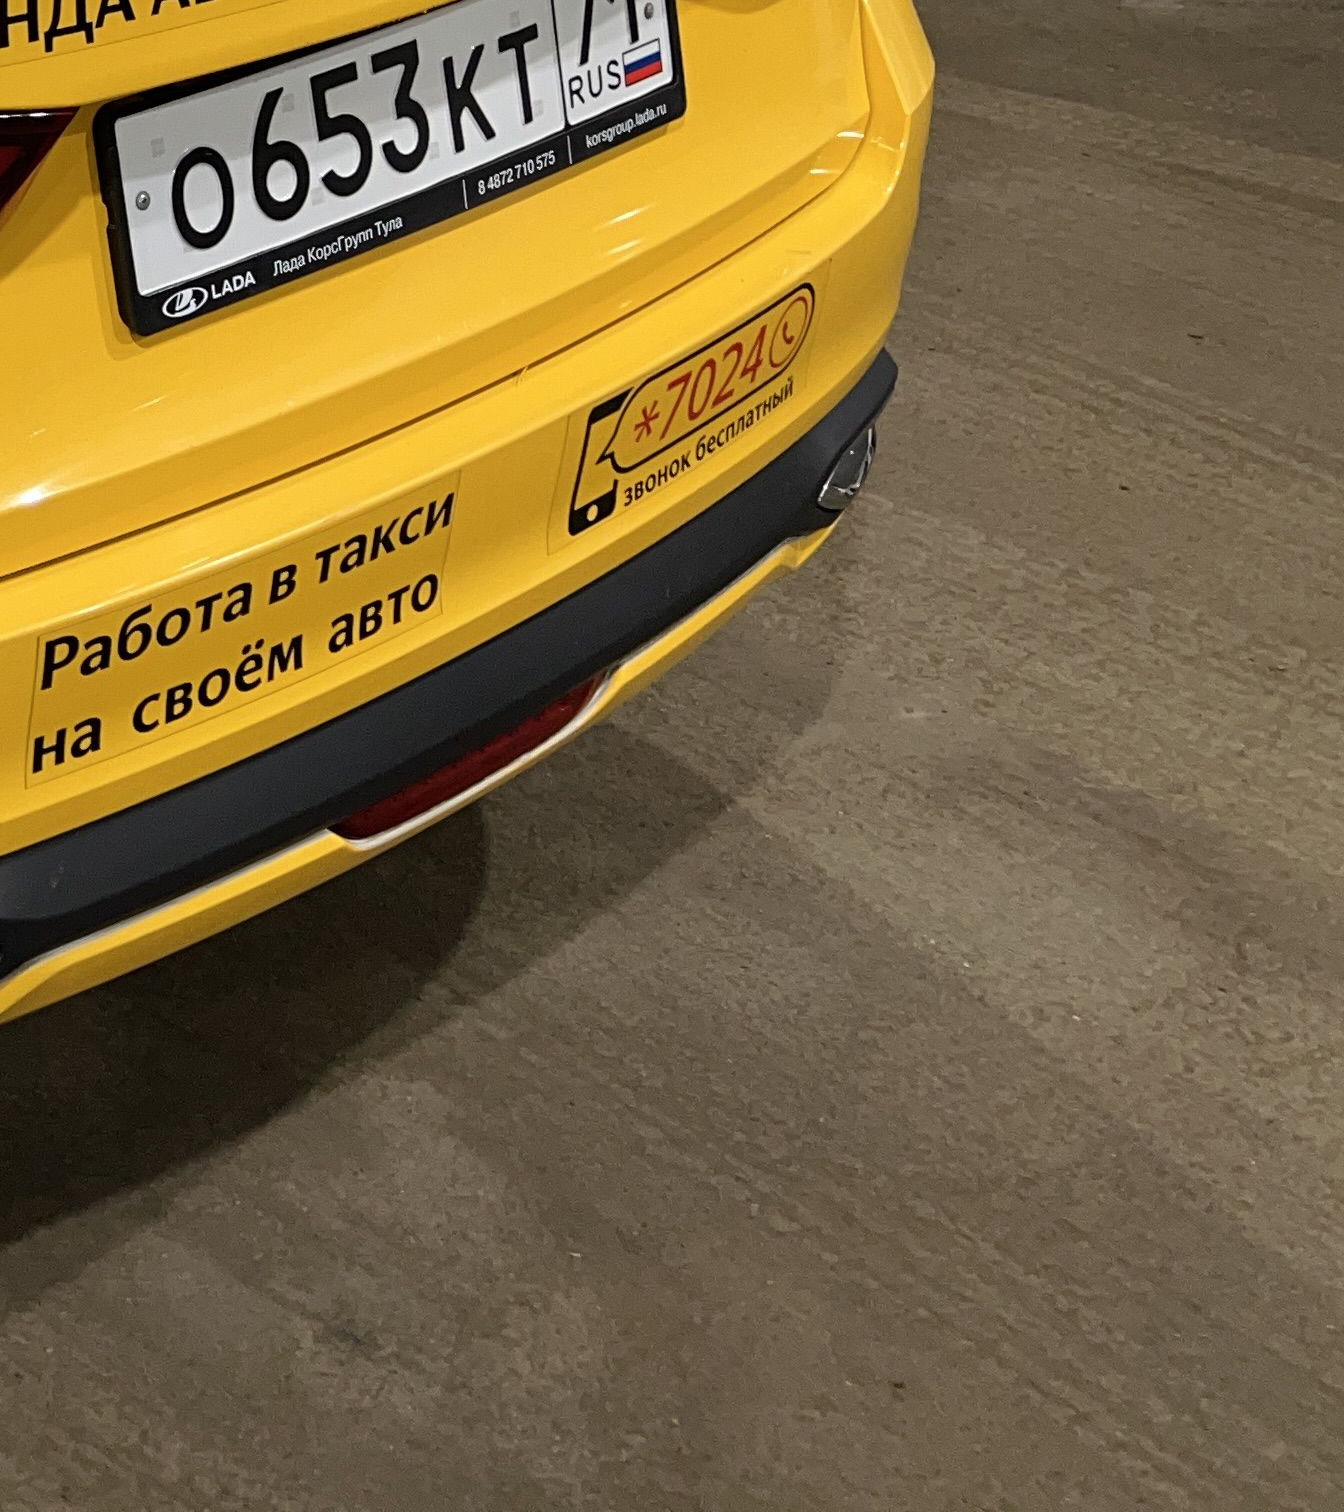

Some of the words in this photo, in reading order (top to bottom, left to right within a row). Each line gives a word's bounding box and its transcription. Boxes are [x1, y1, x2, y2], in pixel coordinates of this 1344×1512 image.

[568, 59, 622, 109] RUS
[585, 103, 668, 149] korsgroup.lada.ru
[477, 179, 487, 196] 8
[487, 168, 514, 190] 4872
[514, 160, 535, 179] 710
[535, 149, 556, 171] 575
[272, 254, 306, 277] Лада
[307, 228, 374, 264] КорсГрупп
[374, 216, 404, 238] Тула
[211, 270, 257, 300] LADA
[623, 450, 692, 508] звонок
[695, 376, 794, 462] бесплатный
[40, 580, 253, 691] Работа
[268, 561, 297, 606] в
[314, 491, 456, 585] такси
[31, 714, 103, 775] на
[132, 634, 306, 734] своём
[327, 571, 441, 655] авто
